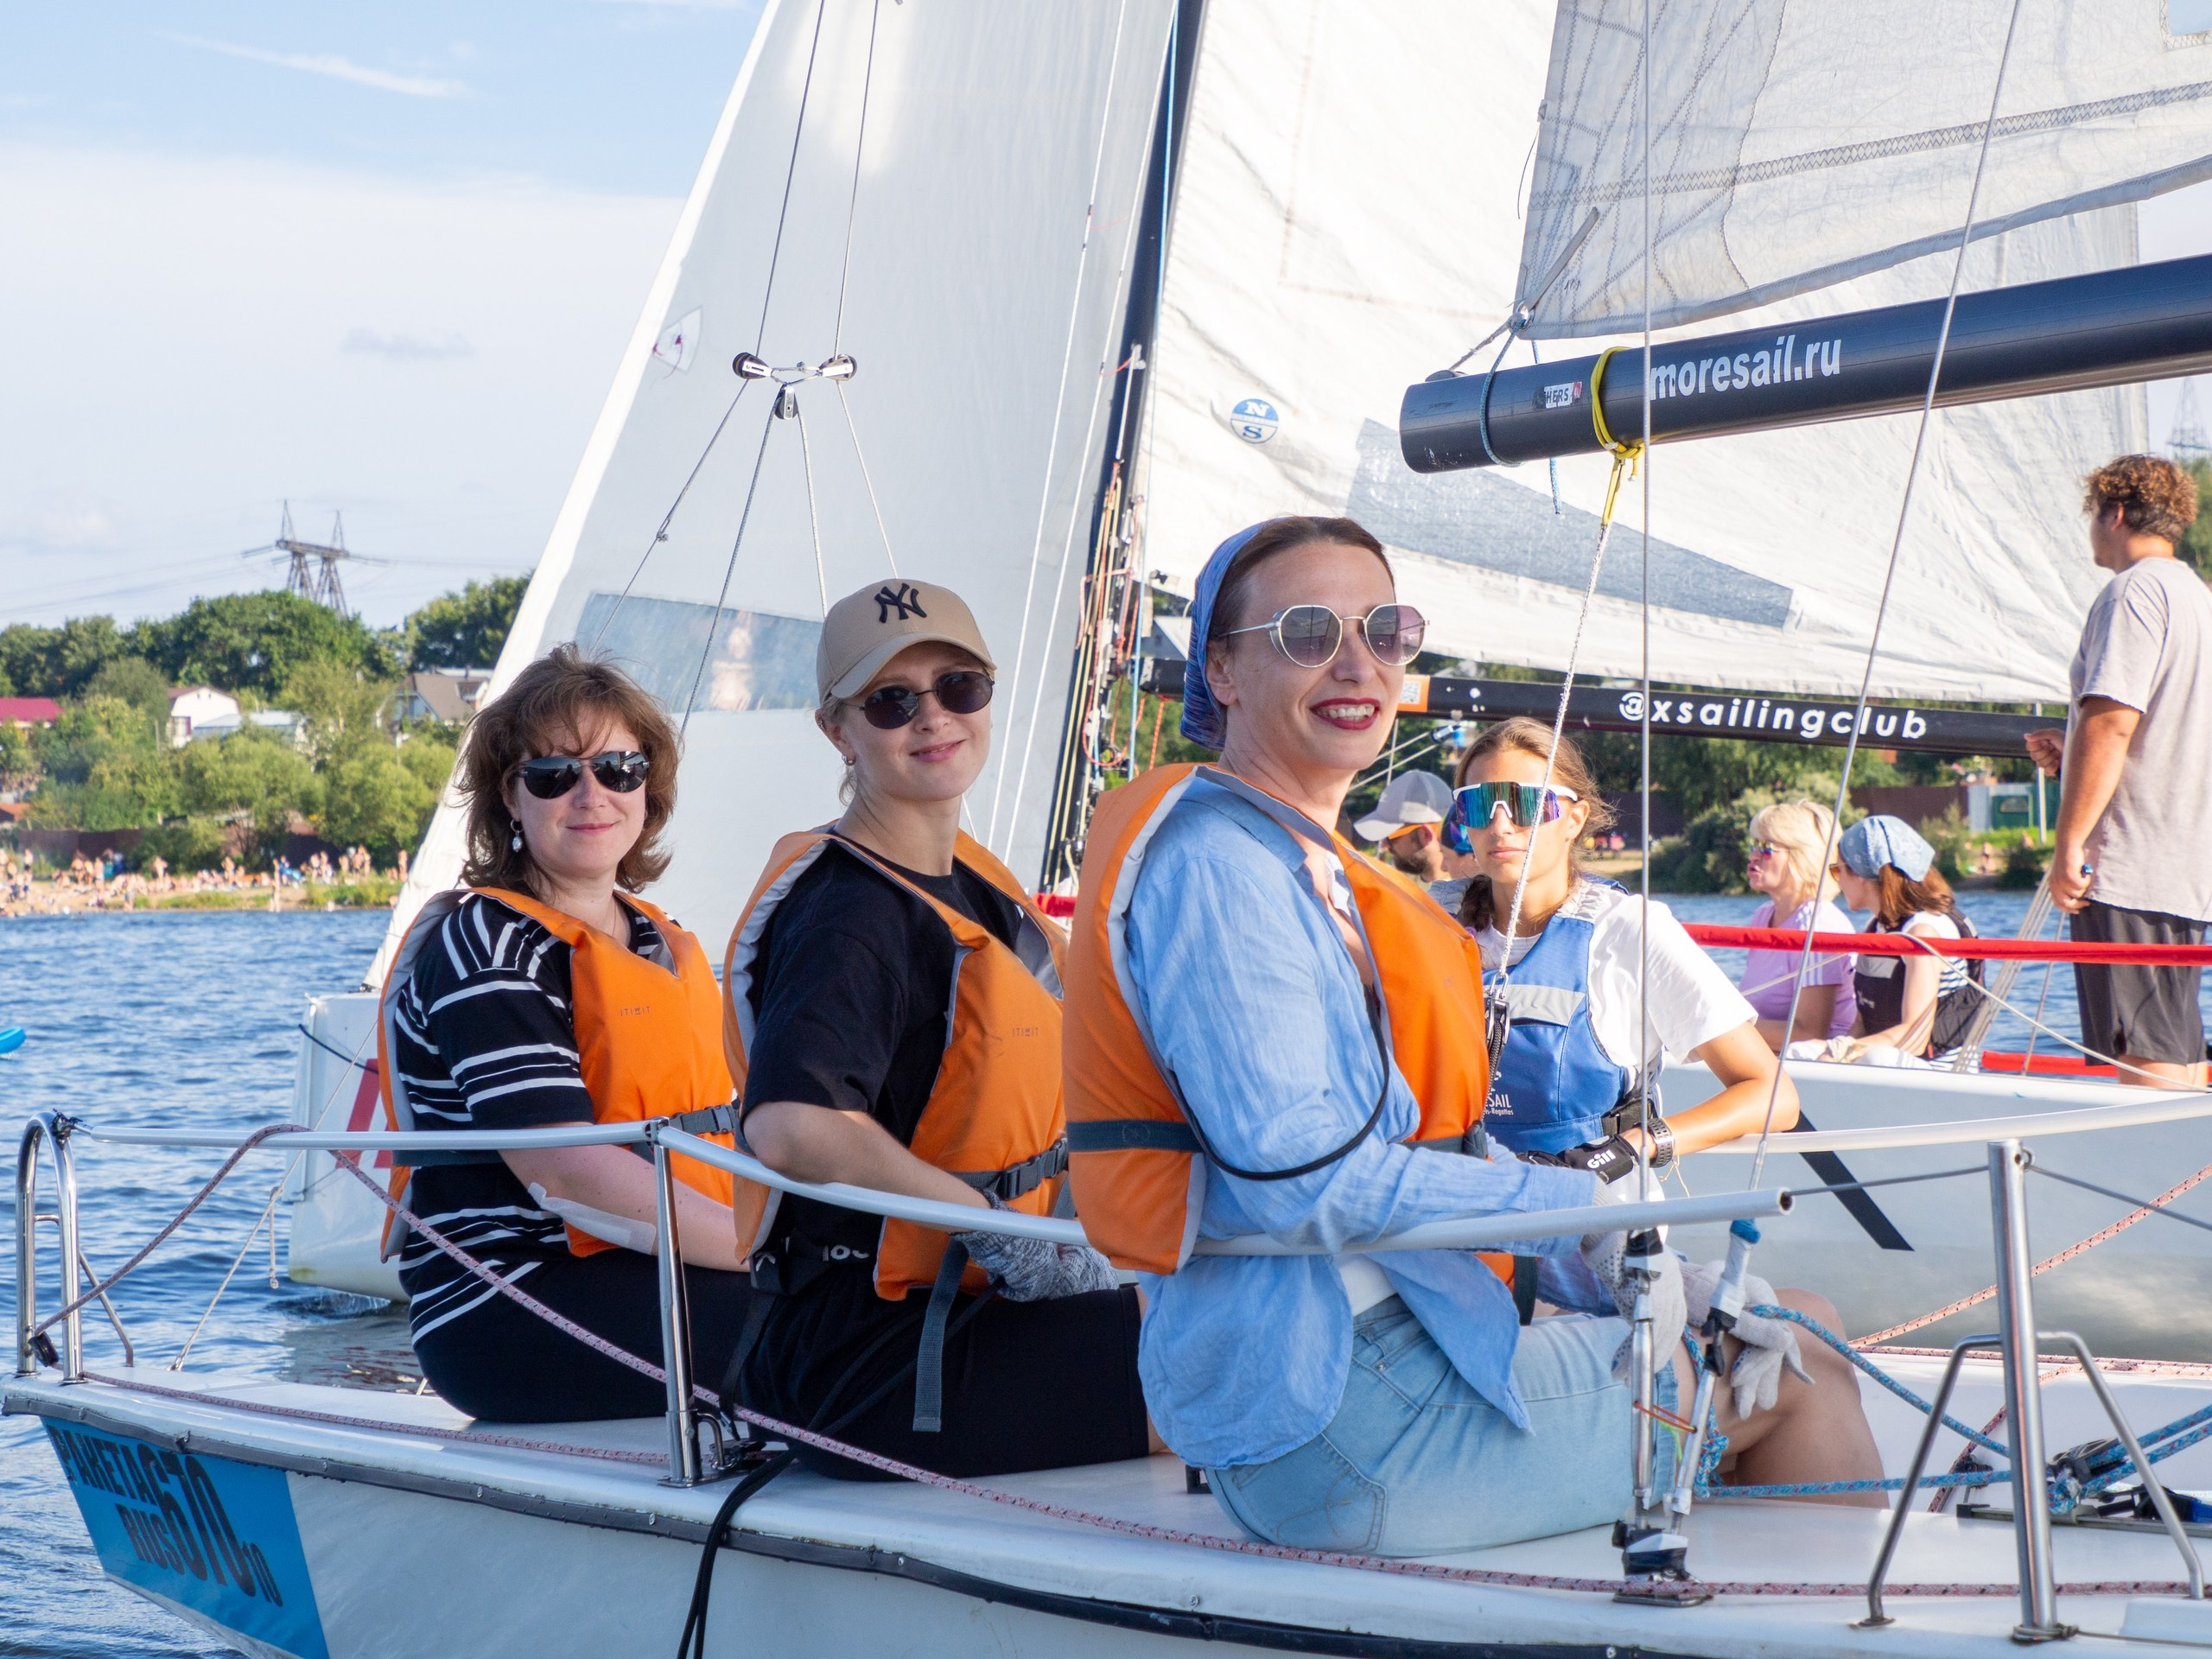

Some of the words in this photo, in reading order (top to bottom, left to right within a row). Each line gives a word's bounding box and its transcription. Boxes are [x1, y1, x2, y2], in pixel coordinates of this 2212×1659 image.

[1649, 334, 1842, 402] moresail.ru
[874, 582, 928, 624] NY
[1618, 691, 1928, 740] @xsailingclub
[1485, 1092, 1512, 1109] SAIL
[1586, 1149, 1617, 1169] Gill
[114, 1503, 186, 1576] RUS
